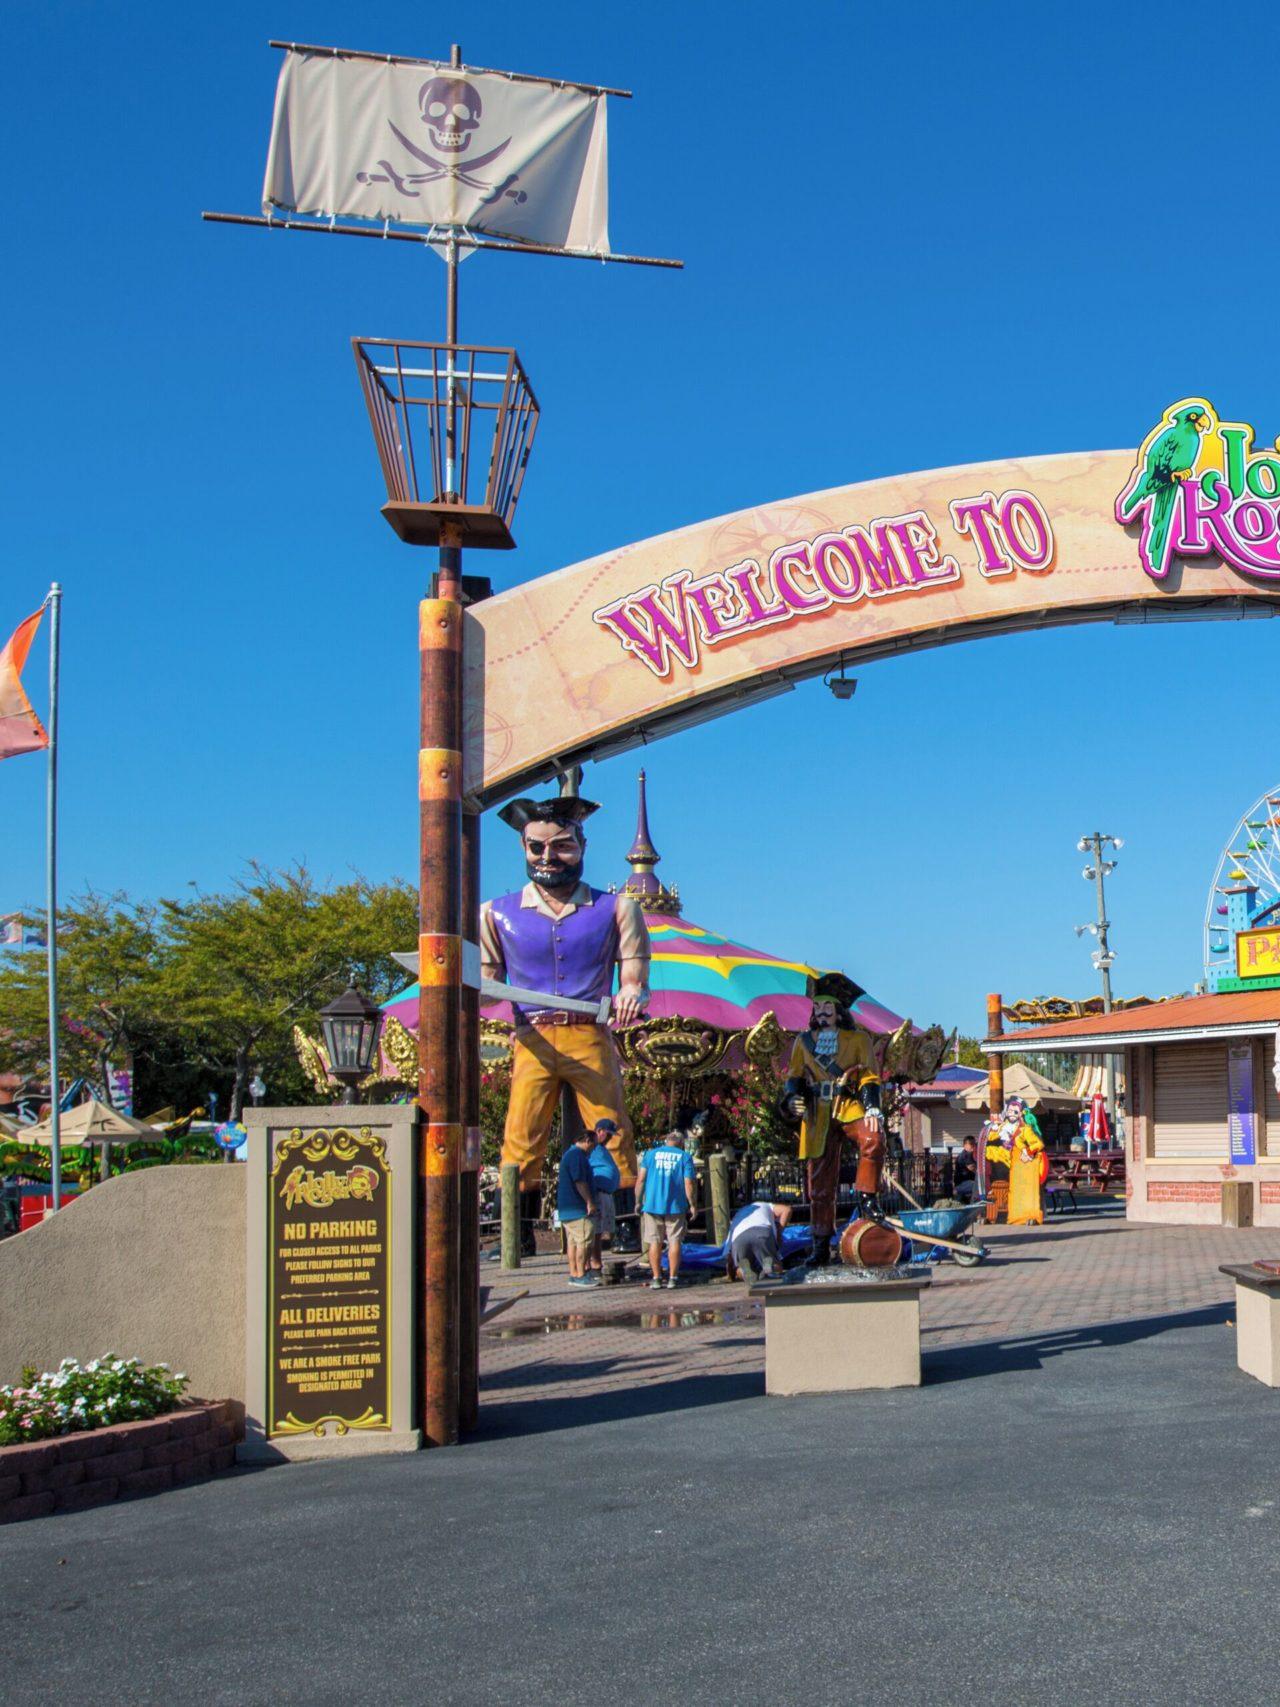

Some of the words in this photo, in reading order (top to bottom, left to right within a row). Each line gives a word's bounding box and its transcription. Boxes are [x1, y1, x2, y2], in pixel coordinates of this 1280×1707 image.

[595, 512, 959, 676] WELCOME
[949, 490, 1053, 577] TO
[284, 1223, 306, 1240] NO
[310, 1219, 377, 1239] PARKING
[279, 1248, 292, 1258] FOR
[292, 1247, 315, 1257] CLOSER
[316, 1245, 340, 1256] ACCESS
[341, 1245, 349, 1255] TO
[350, 1244, 360, 1254] ALL
[361, 1243, 382, 1254] PARKS
[285, 1260, 308, 1271] PLEASE
[308, 1259, 333, 1270] FOLLOW
[333, 1258, 353, 1269] SIGNS
[353, 1258, 361, 1267] TO
[362, 1257, 376, 1267] OUR
[290, 1273, 325, 1284] PREFERRED
[326, 1272, 353, 1283] PARKING
[354, 1271, 370, 1281] AREA
[280, 1308, 303, 1325] ALL
[306, 1304, 380, 1324] DELIVERIES
[283, 1329, 304, 1339] PLEASE
[304, 1329, 316, 1338] USE
[316, 1328, 332, 1337] PARK
[332, 1327, 348, 1336] BACK
[348, 1325, 378, 1335] ENTRANCE
[279, 1358, 292, 1370] WE
[293, 1357, 308, 1369] ARE
[308, 1357, 314, 1368] A
[315, 1355, 342, 1367] SMOKE
[342, 1354, 360, 1366] FREE
[361, 1353, 381, 1364] PARK
[286, 1372, 319, 1384] SMOKING
[320, 1371, 328, 1381] IS
[328, 1369, 365, 1381] PERMITTED
[365, 1368, 374, 1378] IN
[299, 1381, 339, 1393] DESIGNATED
[340, 1379, 362, 1390] AREAS
